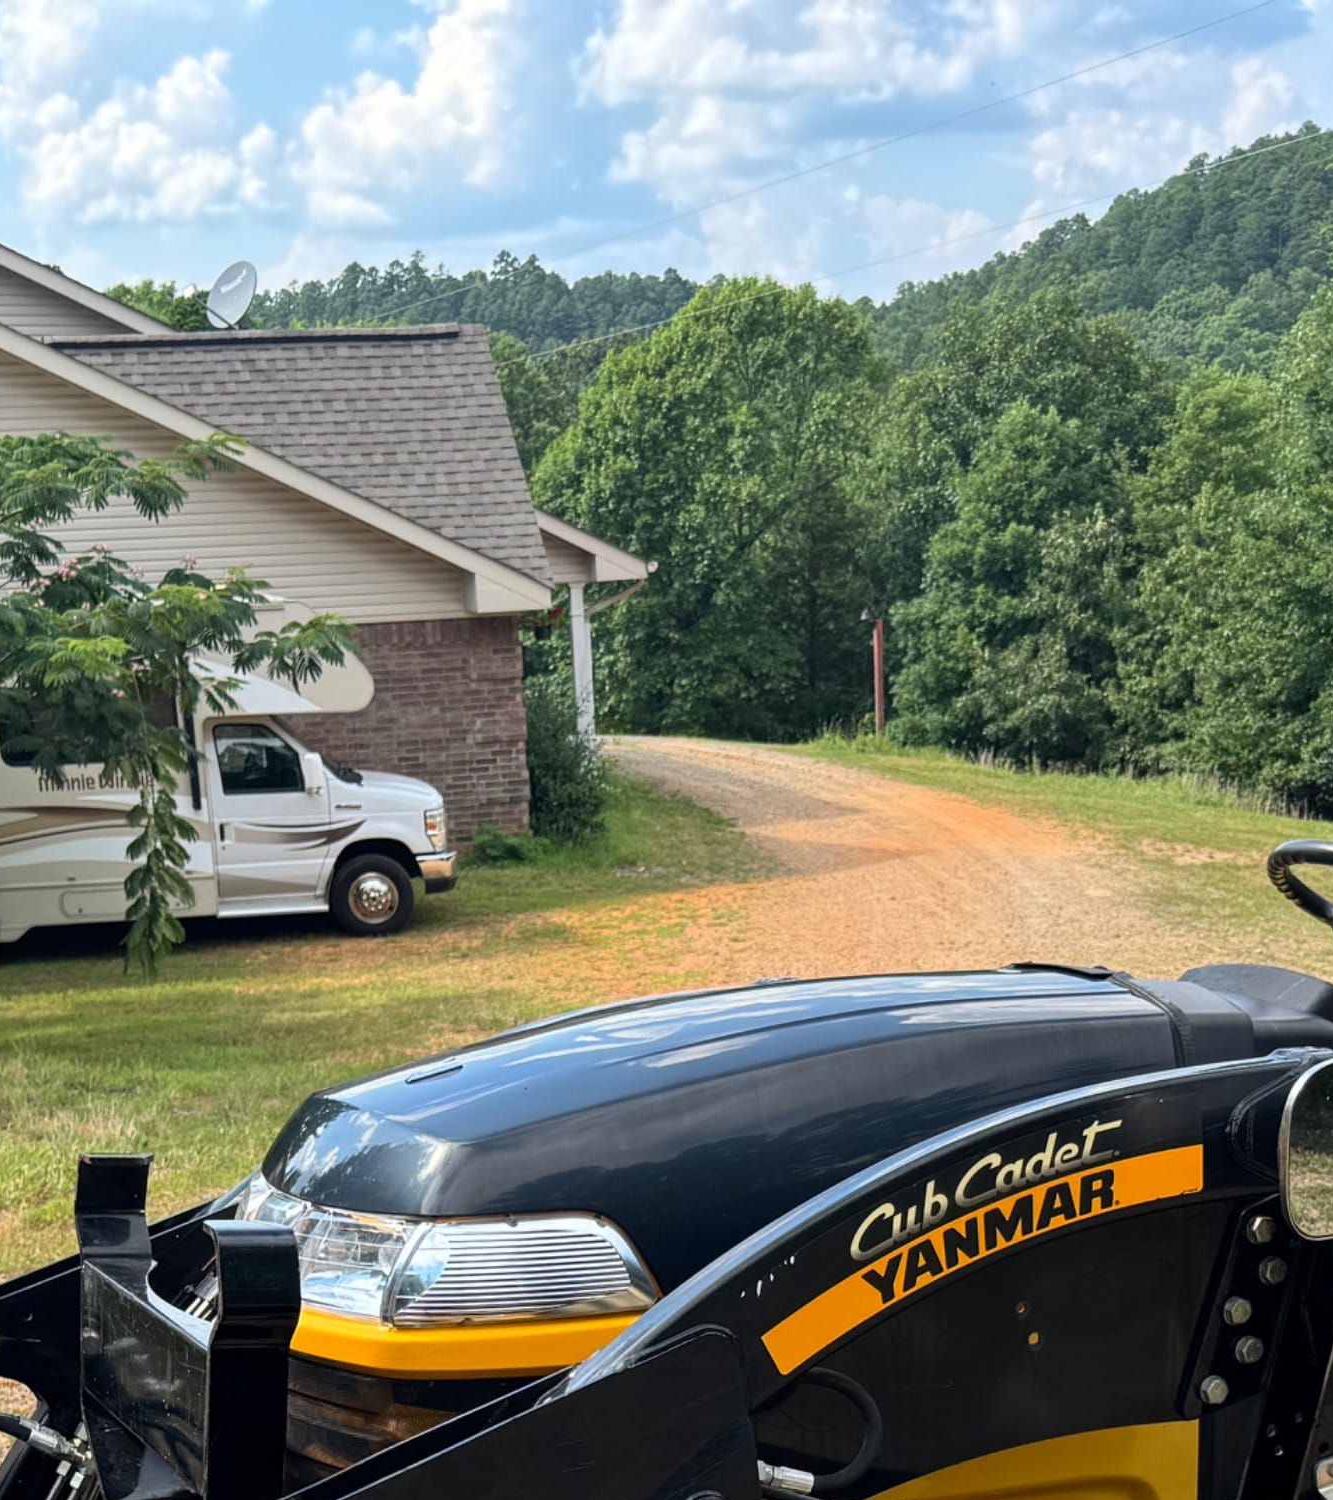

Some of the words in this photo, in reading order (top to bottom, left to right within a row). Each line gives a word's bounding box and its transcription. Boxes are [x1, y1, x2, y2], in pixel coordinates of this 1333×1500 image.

[850, 1179, 948, 1261] Cub
[954, 1119, 1124, 1208] Cadet
[861, 1168, 1117, 1305] YANMAR
